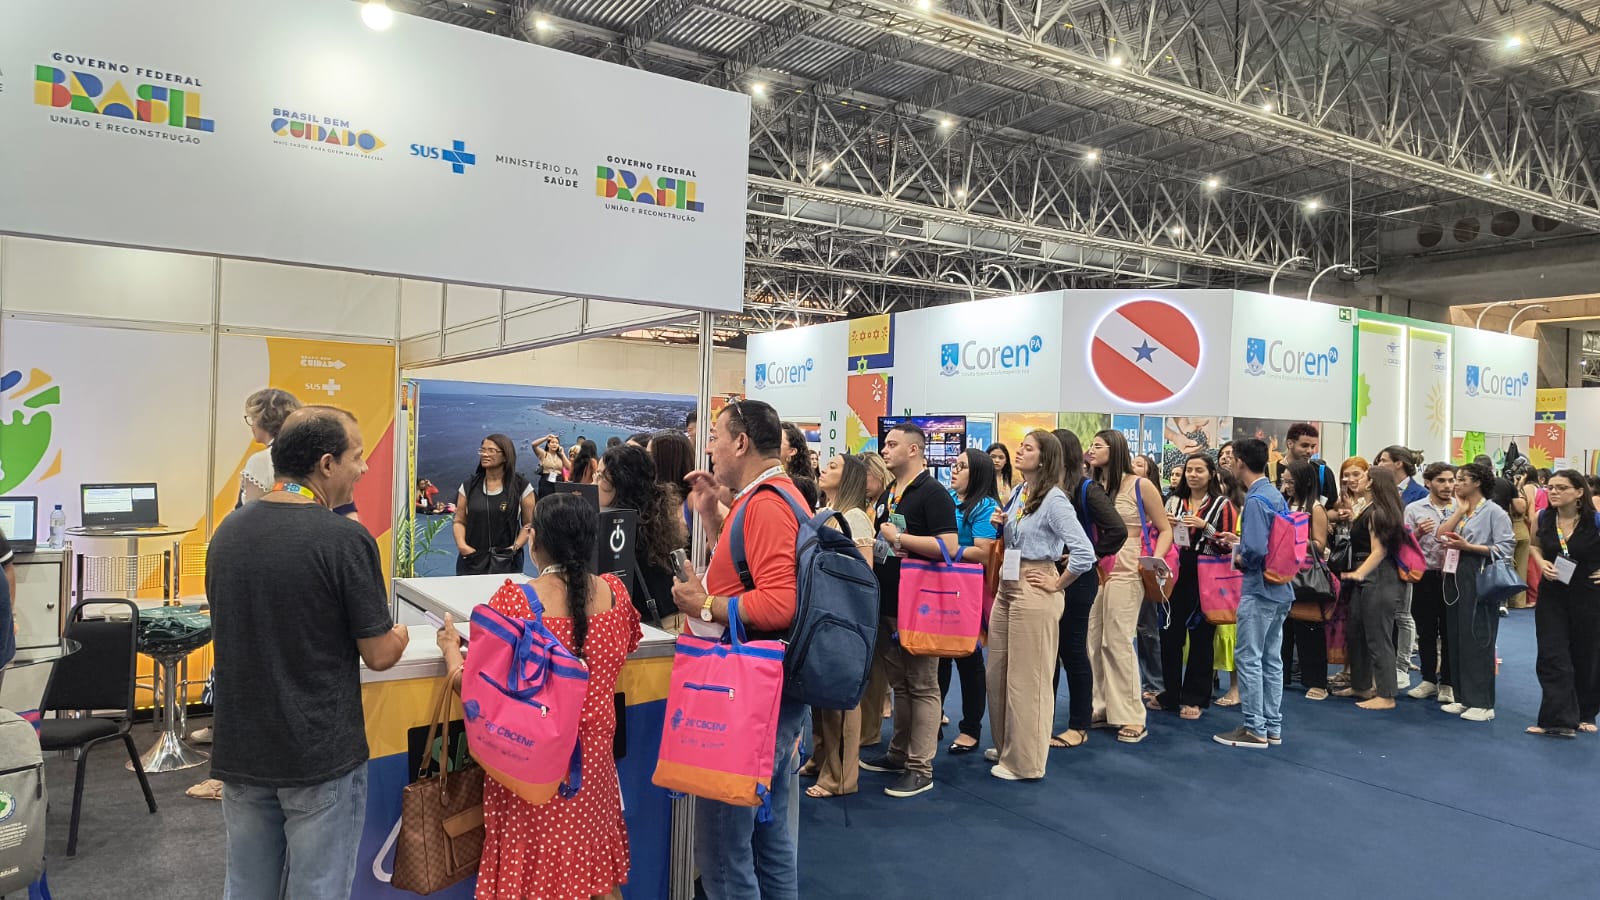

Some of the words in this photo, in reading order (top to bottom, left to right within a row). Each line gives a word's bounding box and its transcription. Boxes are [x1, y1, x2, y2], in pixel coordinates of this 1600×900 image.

[53, 52, 129, 73] GOVERNO
[136, 67, 202, 87] FEDERAL
[34, 64, 215, 132] BRASIL
[50, 114, 90, 127] UNIÃO
[106, 123, 200, 145] RECONSTRUÇÃO
[273, 108, 320, 123] BRASIL
[323, 116, 350, 128] BEM
[271, 118, 386, 154] CUIDADO
[410, 143, 439, 159] SUS
[496, 155, 561, 173] MINISTÉRIO
[565, 167, 579, 176] DA
[607, 156, 653, 170] GOVERNO
[656, 164, 697, 178] FEDERAL
[544, 176, 579, 188] SAÚDE
[596, 165, 704, 212] BRASIL
[605, 204, 629, 213] UNIÃO
[639, 208, 696, 222] RECONSTRUÇÃO
[962, 340, 1029, 370] Coren
[1030, 340, 1041, 349] PA
[1268, 340, 1328, 376] Coren
[767, 361, 806, 385] Coren
[1481, 366, 1521, 397] Coren
[1124, 428, 1152, 441] BELM
